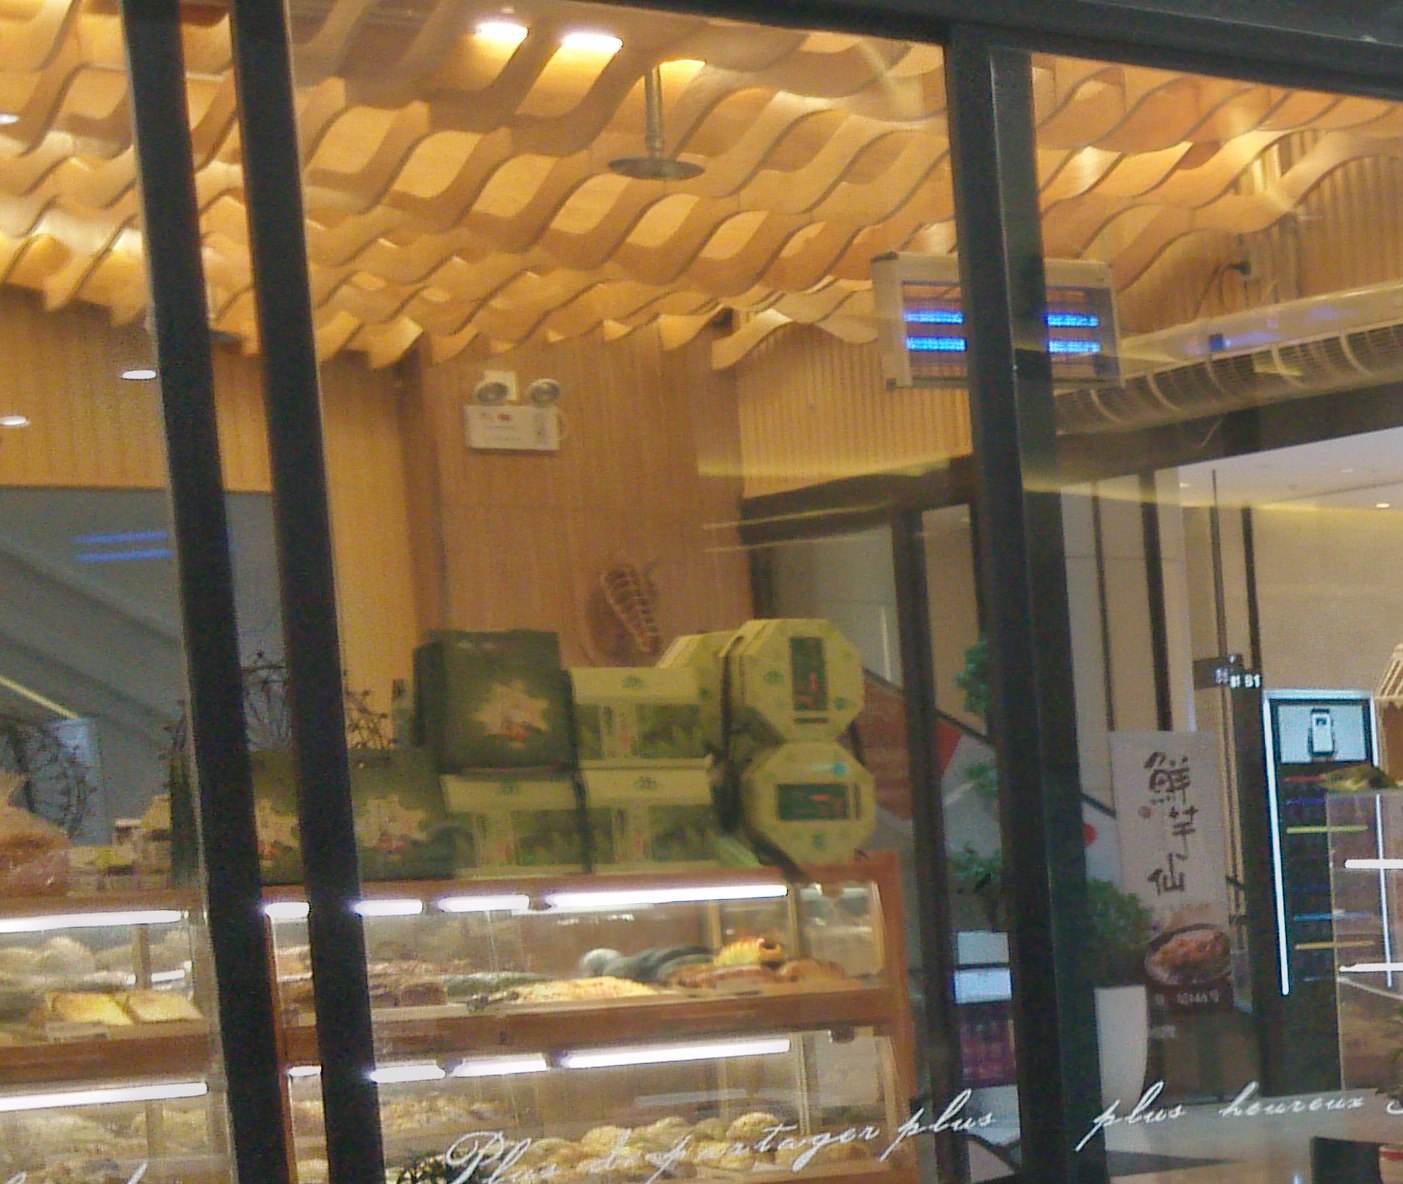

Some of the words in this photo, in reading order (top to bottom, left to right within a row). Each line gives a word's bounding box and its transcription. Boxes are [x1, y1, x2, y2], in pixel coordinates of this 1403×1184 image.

[882, 1088, 996, 1161] plus
[1075, 1080, 1187, 1152] plus
[1217, 1081, 1365, 1118] heureux
